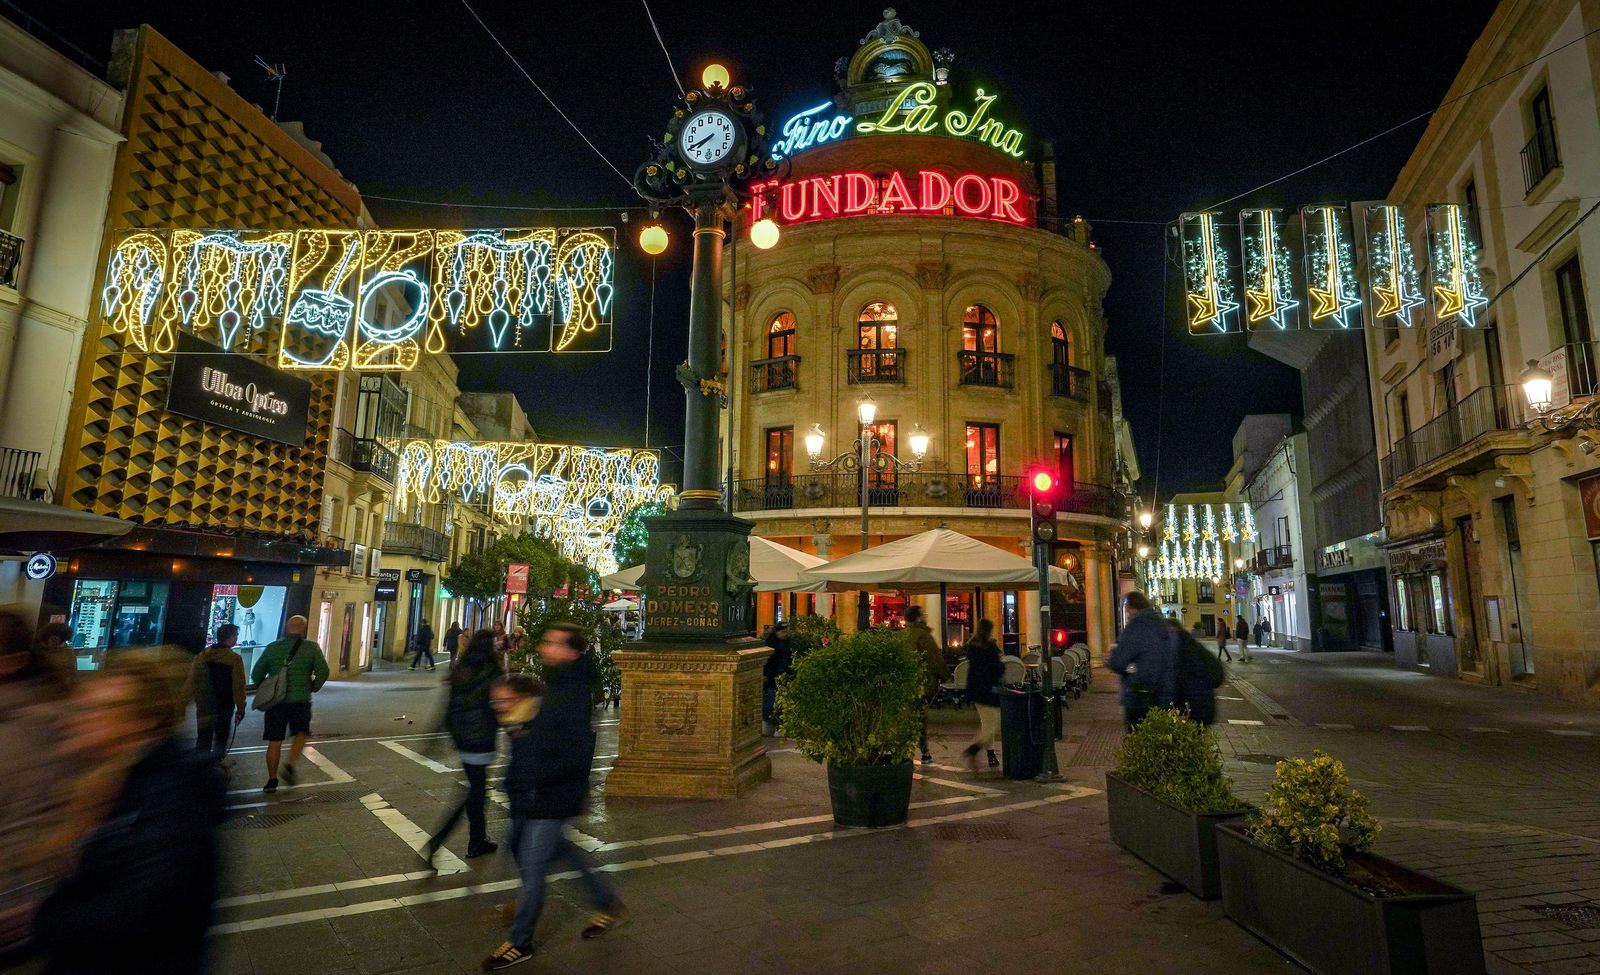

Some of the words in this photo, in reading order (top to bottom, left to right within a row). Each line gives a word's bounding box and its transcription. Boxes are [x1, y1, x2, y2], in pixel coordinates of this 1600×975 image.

[772, 101, 853, 161] Fino
[856, 82, 938, 133] La
[751, 170, 1026, 223] FUNDADOR
[201, 366, 243, 401] Ulloa
[210, 399, 233, 412] ÓPTICA
[657, 585, 710, 597] PEDRO
[647, 600, 719, 615] DOMECQ
